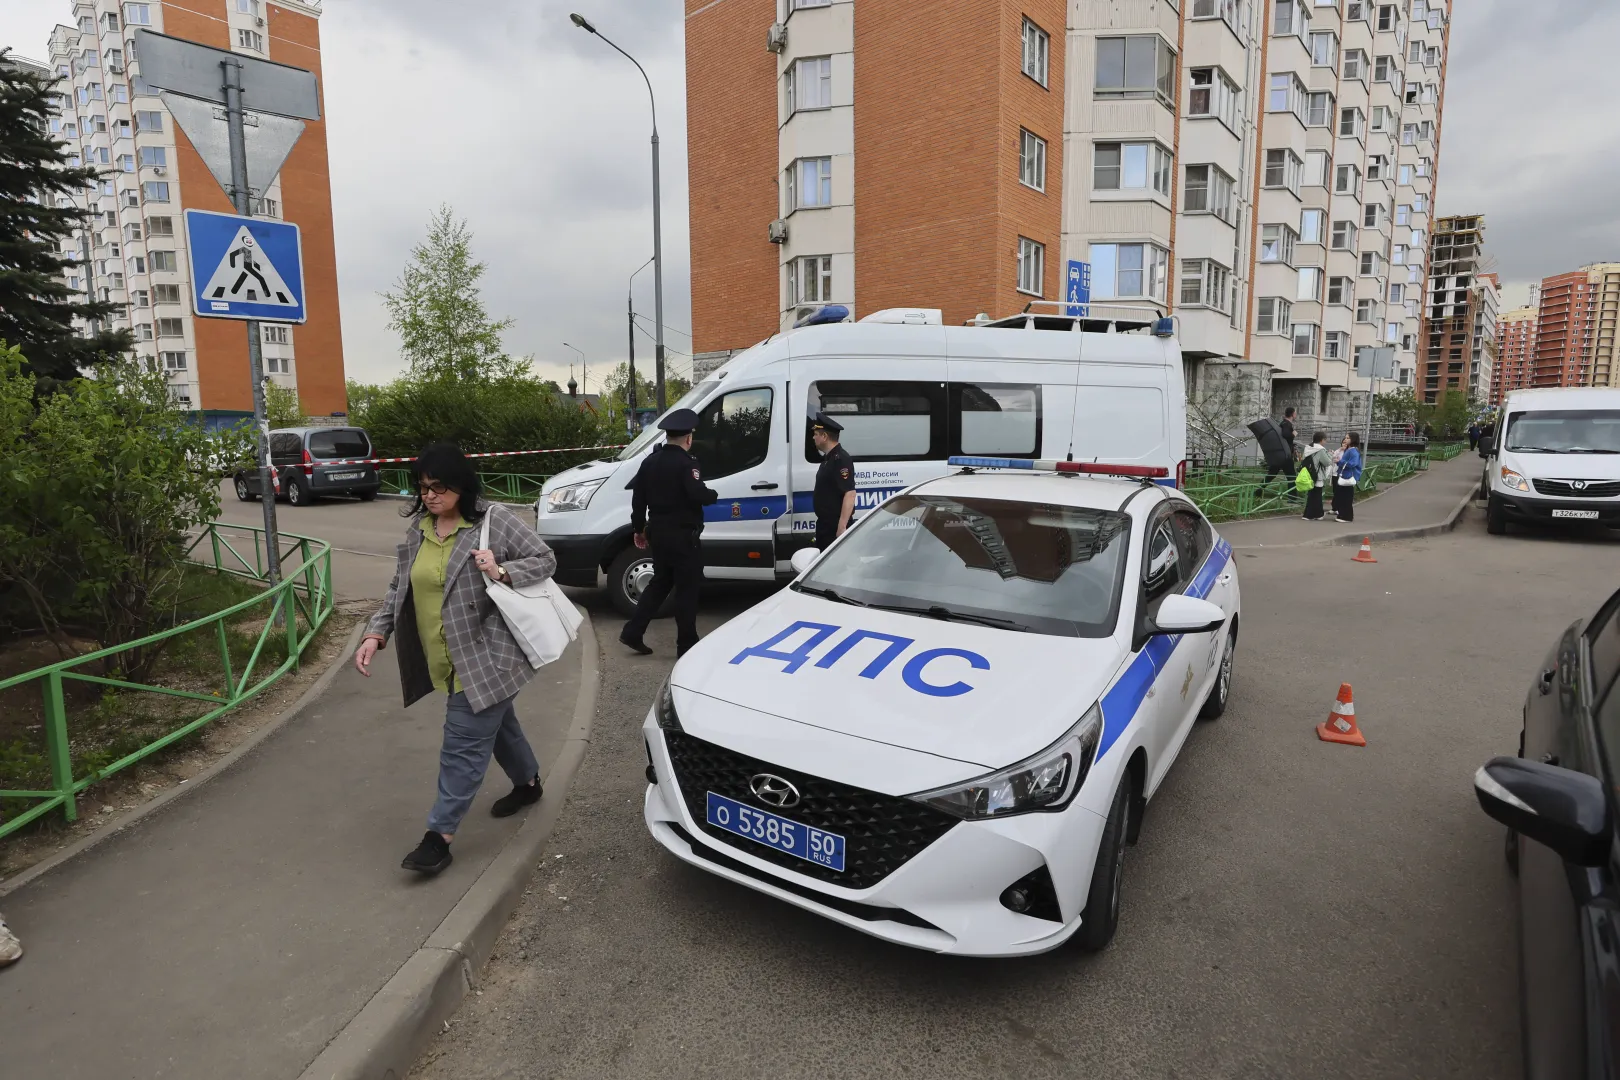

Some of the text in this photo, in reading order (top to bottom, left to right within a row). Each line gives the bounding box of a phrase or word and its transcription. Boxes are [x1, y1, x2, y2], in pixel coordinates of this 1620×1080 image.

[793, 520, 816, 531] ЛАБ
[728, 620, 991, 698] ДПС
[738, 807, 795, 849] 5385
[810, 830, 835, 856] 50
[813, 852, 832, 865] RUS
